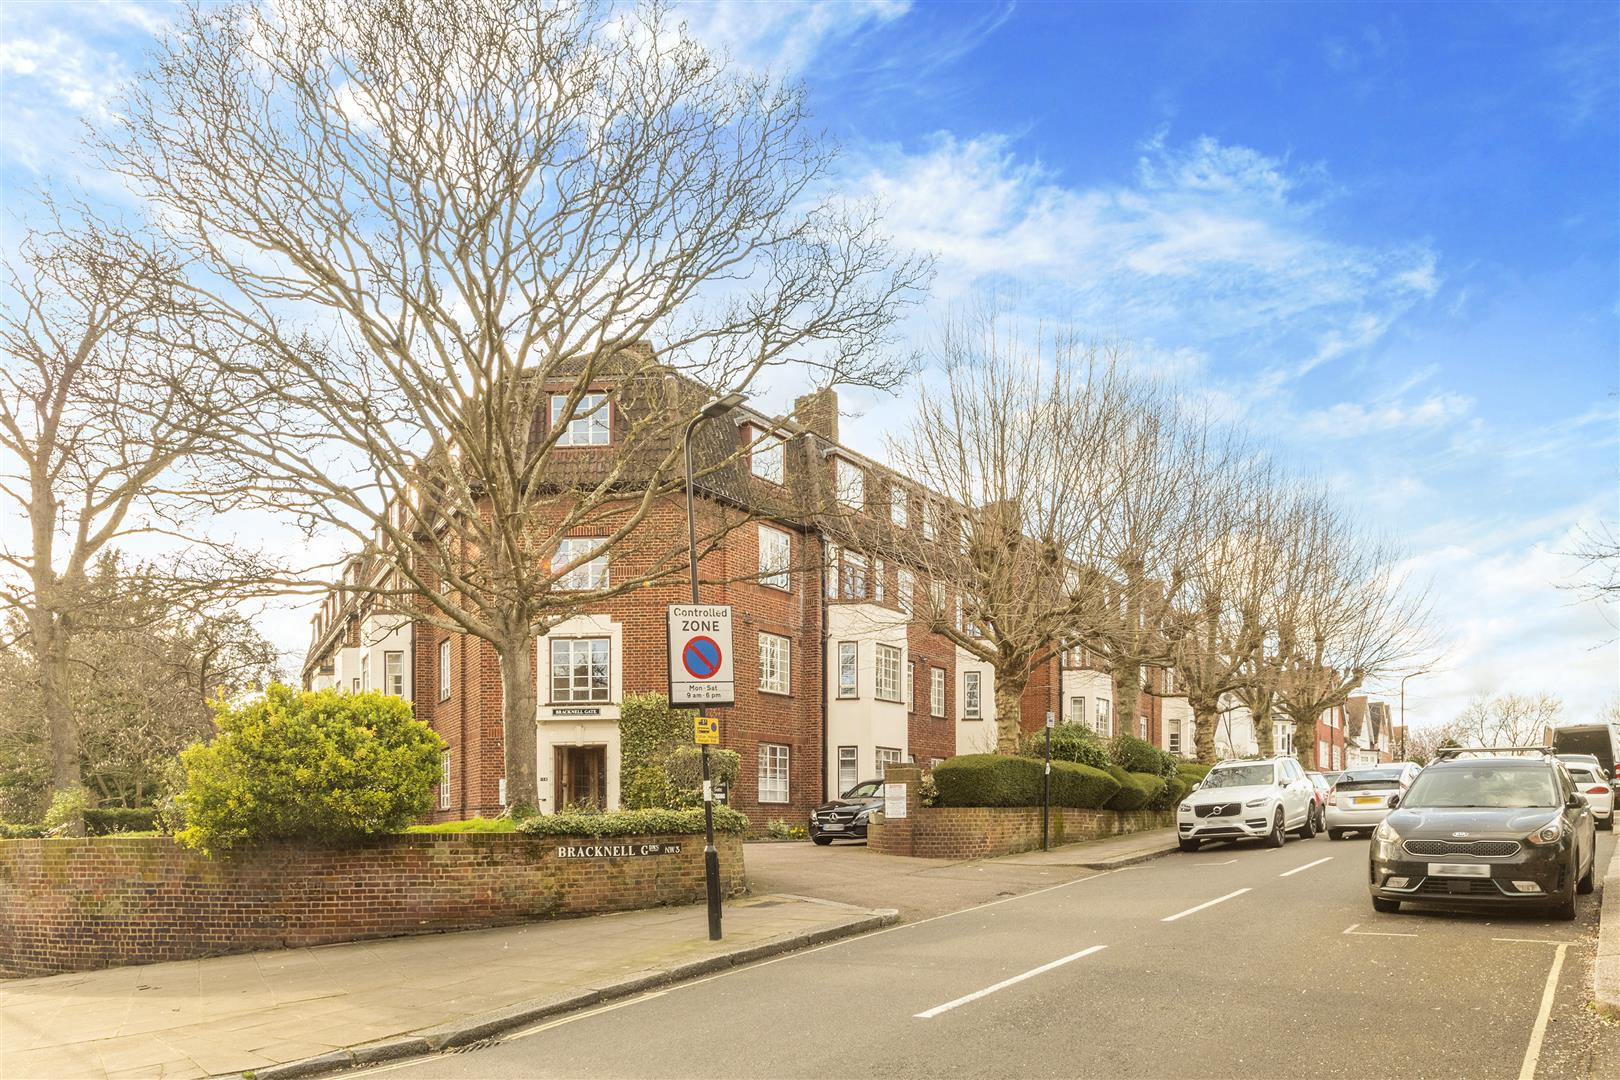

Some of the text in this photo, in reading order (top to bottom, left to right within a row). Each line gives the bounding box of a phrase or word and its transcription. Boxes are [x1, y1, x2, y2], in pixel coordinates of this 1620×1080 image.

[673, 607, 728, 618] Controlled
[682, 620, 720, 632] ZONE
[558, 846, 636, 858] BRACKNELL
